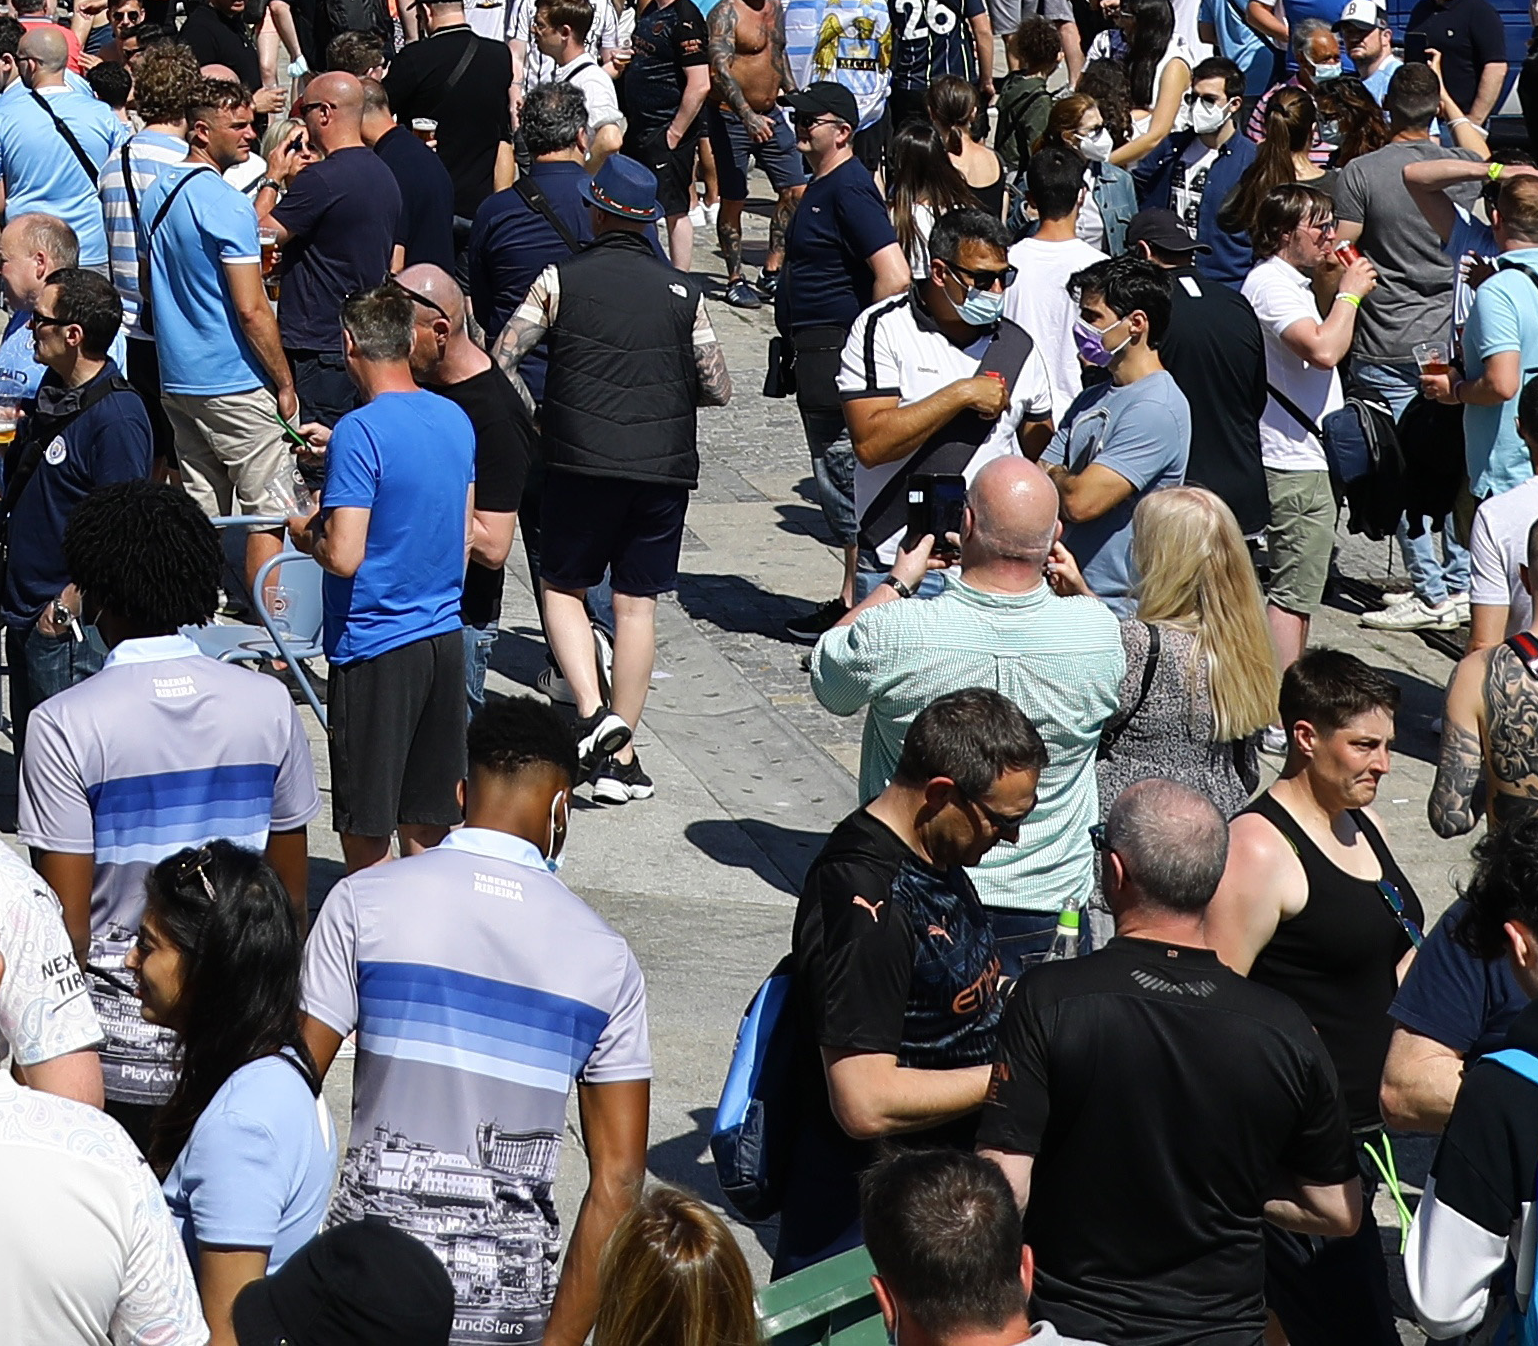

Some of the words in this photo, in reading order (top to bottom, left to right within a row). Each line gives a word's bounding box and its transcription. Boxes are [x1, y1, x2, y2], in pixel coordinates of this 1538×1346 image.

[153, 675, 194, 687] TABERNA
[155, 686, 197, 698] RIBEIRA
[473, 873, 523, 891] TABERNA
[473, 882, 524, 902] RIBEIRA
